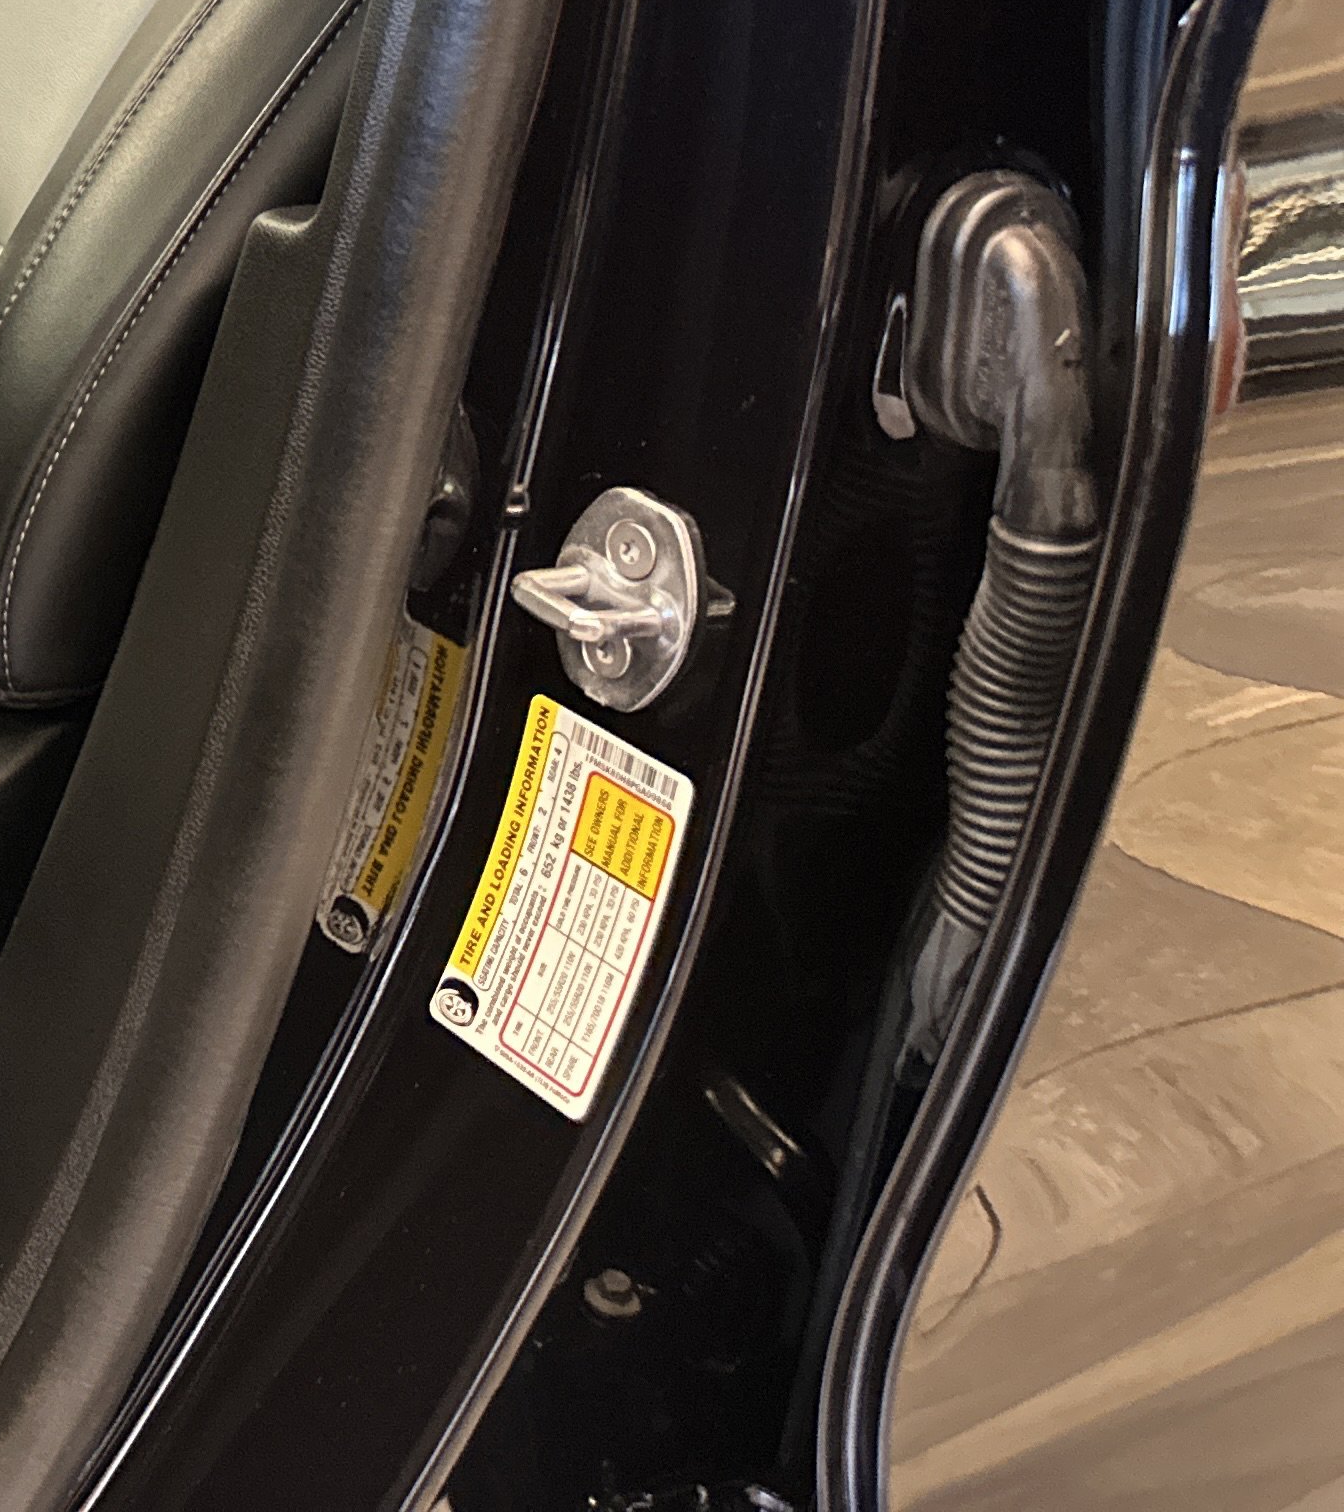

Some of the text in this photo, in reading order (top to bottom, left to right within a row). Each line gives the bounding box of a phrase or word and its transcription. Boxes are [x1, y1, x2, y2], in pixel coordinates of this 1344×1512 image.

[569, 762, 583, 782] lbs.
[518, 867, 528, 877] 6
[537, 806, 547, 817] 2
[554, 747, 563, 757] 4
[560, 781, 577, 814] 1438
[459, 705, 551, 965] TIRE AND LOADING INFORMATION
[557, 816, 568, 832] or
[584, 789, 609, 857] SEE OWNERS
[600, 798, 628, 868] MANUAL FOR
[550, 832, 565, 850] kg
[619, 812, 645, 876] ADDITIONAL
[635, 816, 664, 890] INFORMATION
[541, 852, 557, 879] 652
[518, 890, 539, 935] occupants
[492, 895, 547, 1026] and cargo should never exceed
[502, 946, 518, 975] weight
[484, 976, 506, 1018] combined
[475, 1017, 488, 1034] The
[528, 1029, 544, 1056] FRONT
[545, 1046, 559, 1068] REAR
[563, 1055, 578, 1081] SPARE
